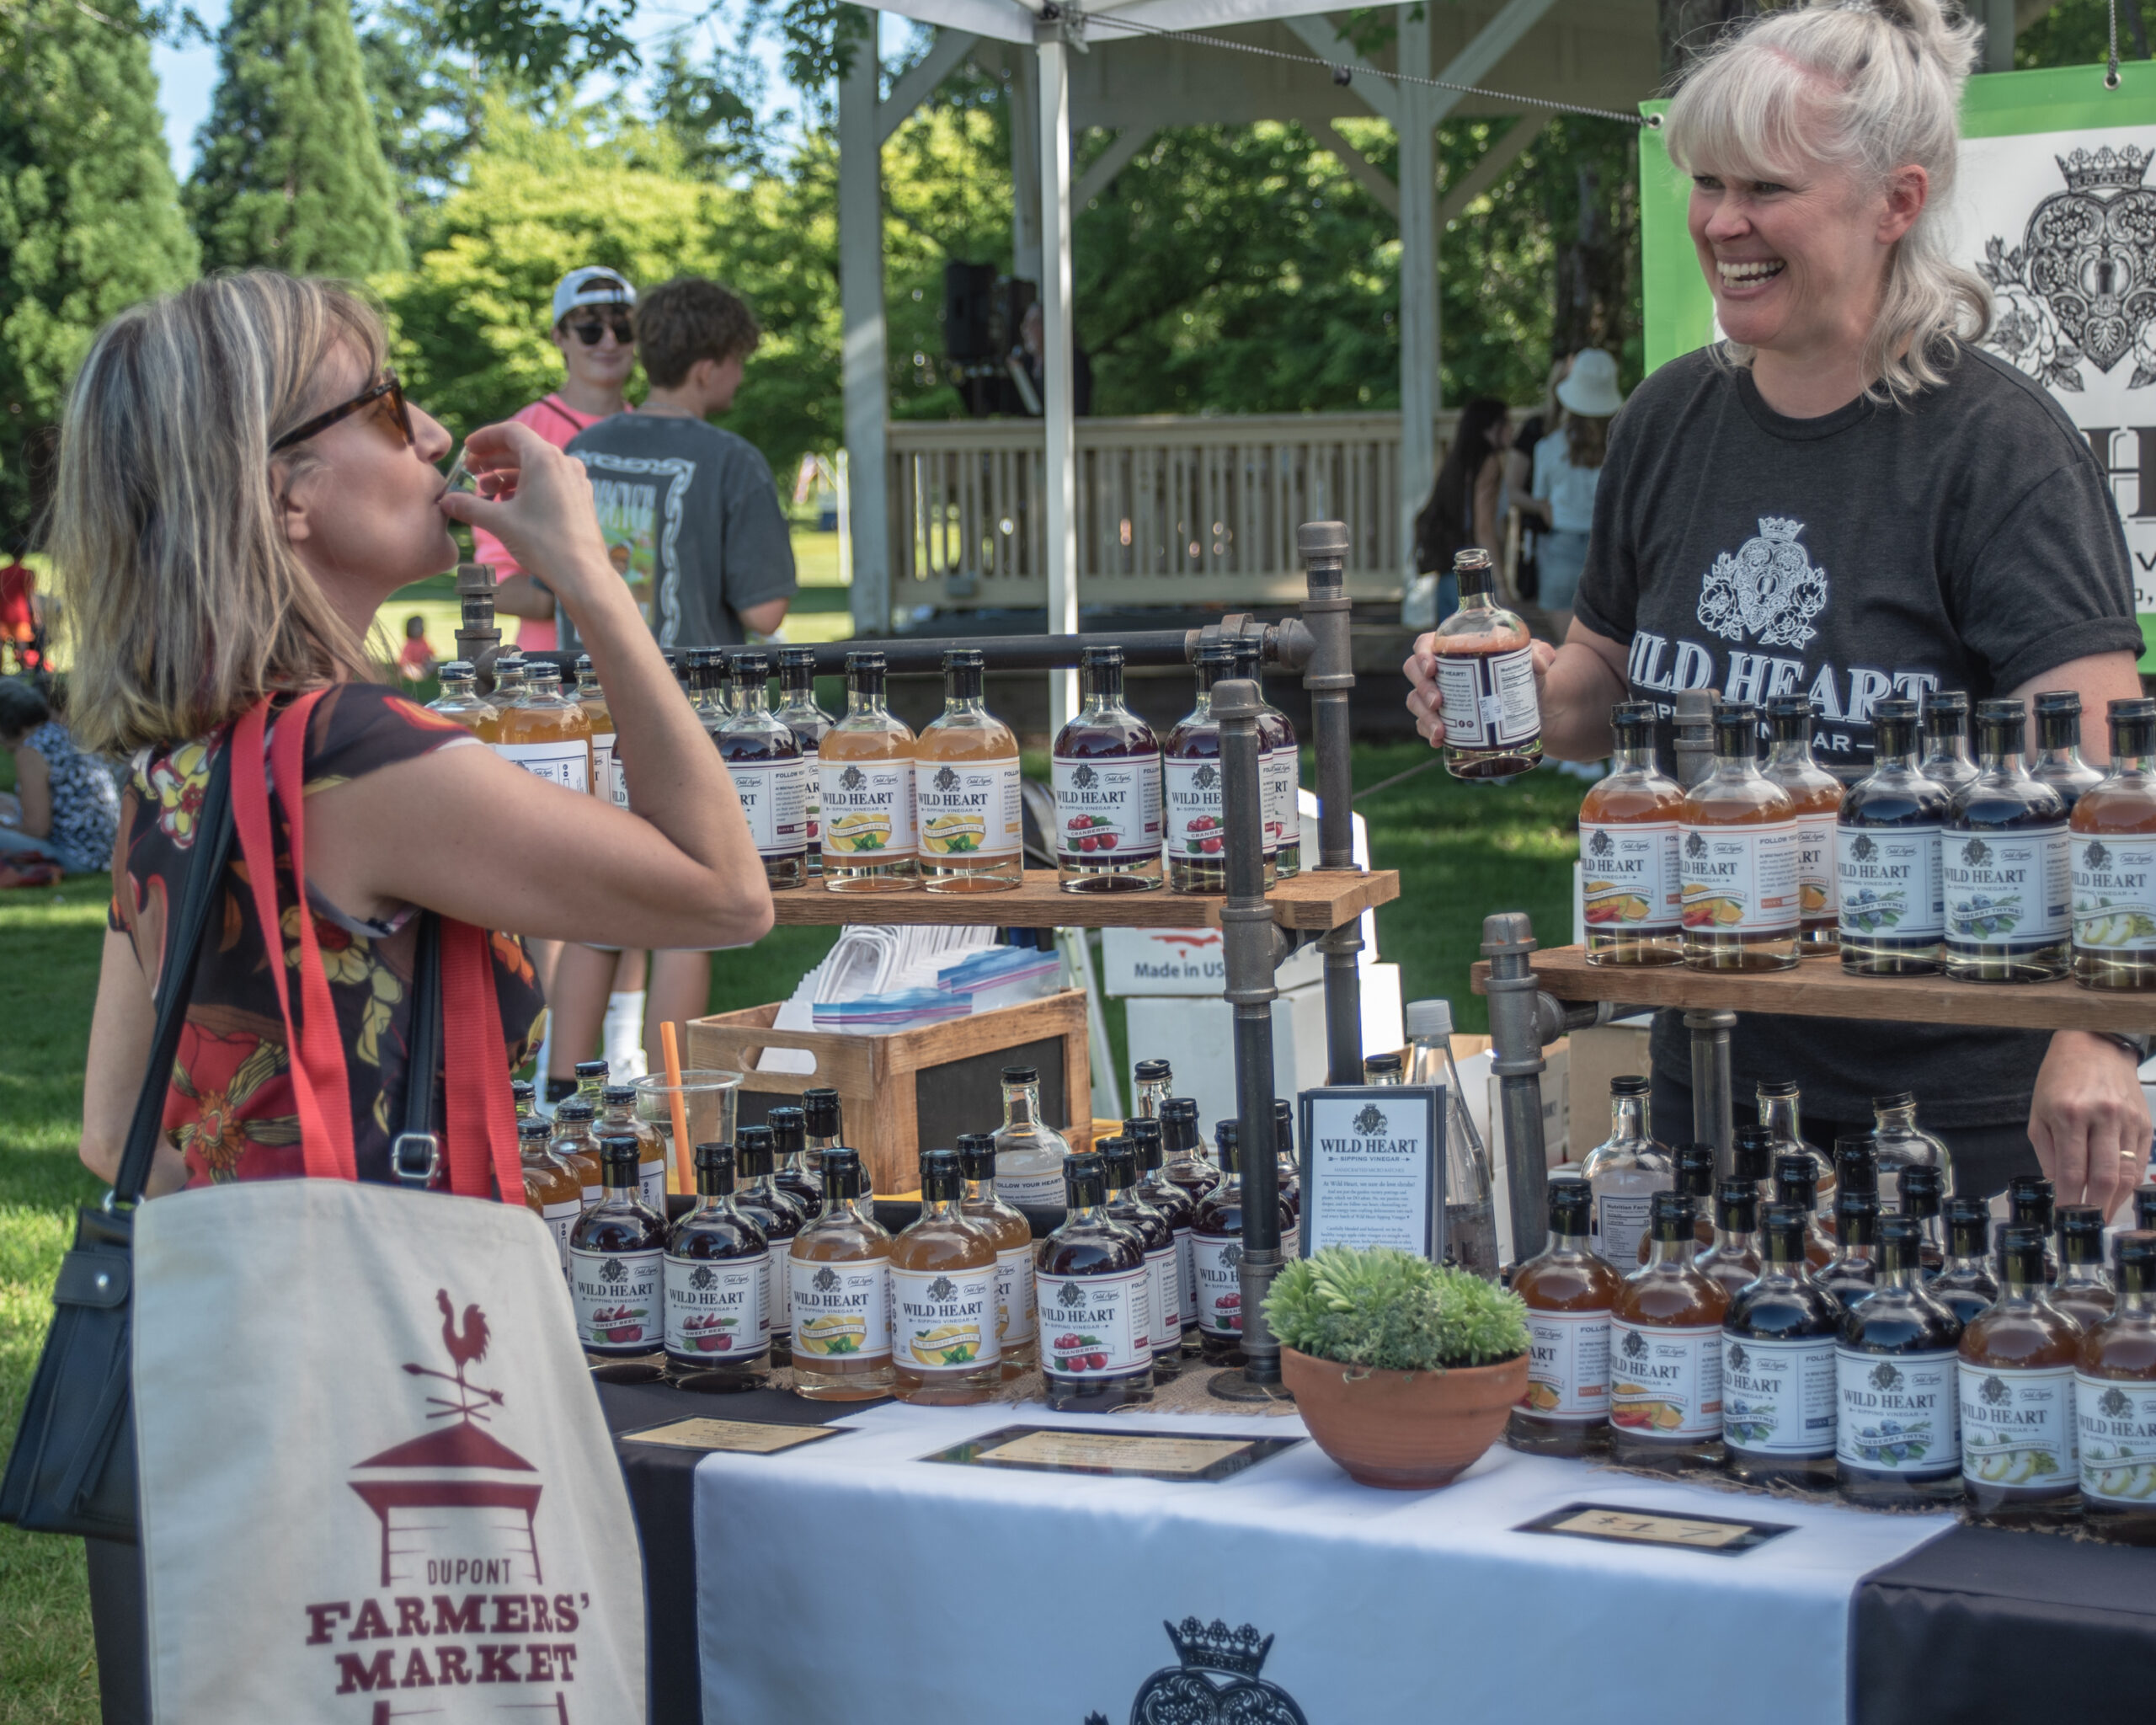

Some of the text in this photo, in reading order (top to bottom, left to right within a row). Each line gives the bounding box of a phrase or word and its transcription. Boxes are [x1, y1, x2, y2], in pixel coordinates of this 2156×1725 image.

[1722, 651, 1938, 727] HEART
[884, 775, 899, 784] Aged
[979, 776, 993, 785] Aged
[1117, 774, 1131, 782] Aged
[823, 792, 894, 806] WILD HEART
[918, 793, 989, 806] WILD HEART
[1057, 790, 1126, 803] WILD HEART
[1171, 792, 1199, 804] WILD
[830, 823, 888, 836] LEMON MINT
[926, 825, 981, 838] LEMON MINT
[1070, 825, 1111, 836] CRANBERRY
[1634, 841, 1650, 852] Aged
[1727, 844, 1744, 854] Aged
[1899, 846, 1917, 856] Aged
[2014, 850, 2032, 861] Aged
[2135, 853, 2153, 863] Aged
[1599, 859, 1645, 873] HEART
[1692, 862, 1738, 875] HEART
[1860, 864, 1911, 879] HEART
[1945, 868, 2026, 884] WILD HEART
[2094, 873, 2147, 887] HEART
[1952, 910, 1990, 920] BLUEBERRY
[1134, 962, 1225, 978] Made in US
[1321, 1139, 1418, 1154] WILD HEART
[645, 1266, 659, 1276] Aged
[1200, 1268, 1227, 1283] WILD
[735, 1275, 750, 1284] Aged
[860, 1277, 874, 1285] Aged
[578, 1282, 654, 1296] WILD HEART
[974, 1284, 986, 1295] Aged
[670, 1289, 744, 1305] WILD HEART
[794, 1291, 869, 1306] WILD HEART
[1105, 1291, 1120, 1301] Aged
[903, 1301, 983, 1316] WILD HEART
[1041, 1308, 1115, 1322] WILD HEART
[1546, 1328, 1563, 1339] Aged
[1058, 1347, 1099, 1356] CRANBERRY
[1670, 1347, 1687, 1357] Aged
[1630, 1363, 1680, 1380] HEART
[1770, 1361, 1787, 1371] Aged
[1733, 1374, 1781, 1394] HEART
[1925, 1375, 1941, 1385] Aged
[1844, 1389, 1936, 1408] WILD HEART
[1961, 1402, 2047, 1424] WILD HEART
[1749, 1415, 1774, 1425] THYME
[2079, 1414, 2107, 1434] WILD
[1854, 1435, 1900, 1446] BLUEBERRY
[428, 1559, 510, 1585] DUPONT
[306, 1592, 590, 1646] FARMERS'
[335, 1642, 578, 1695] MARKET
